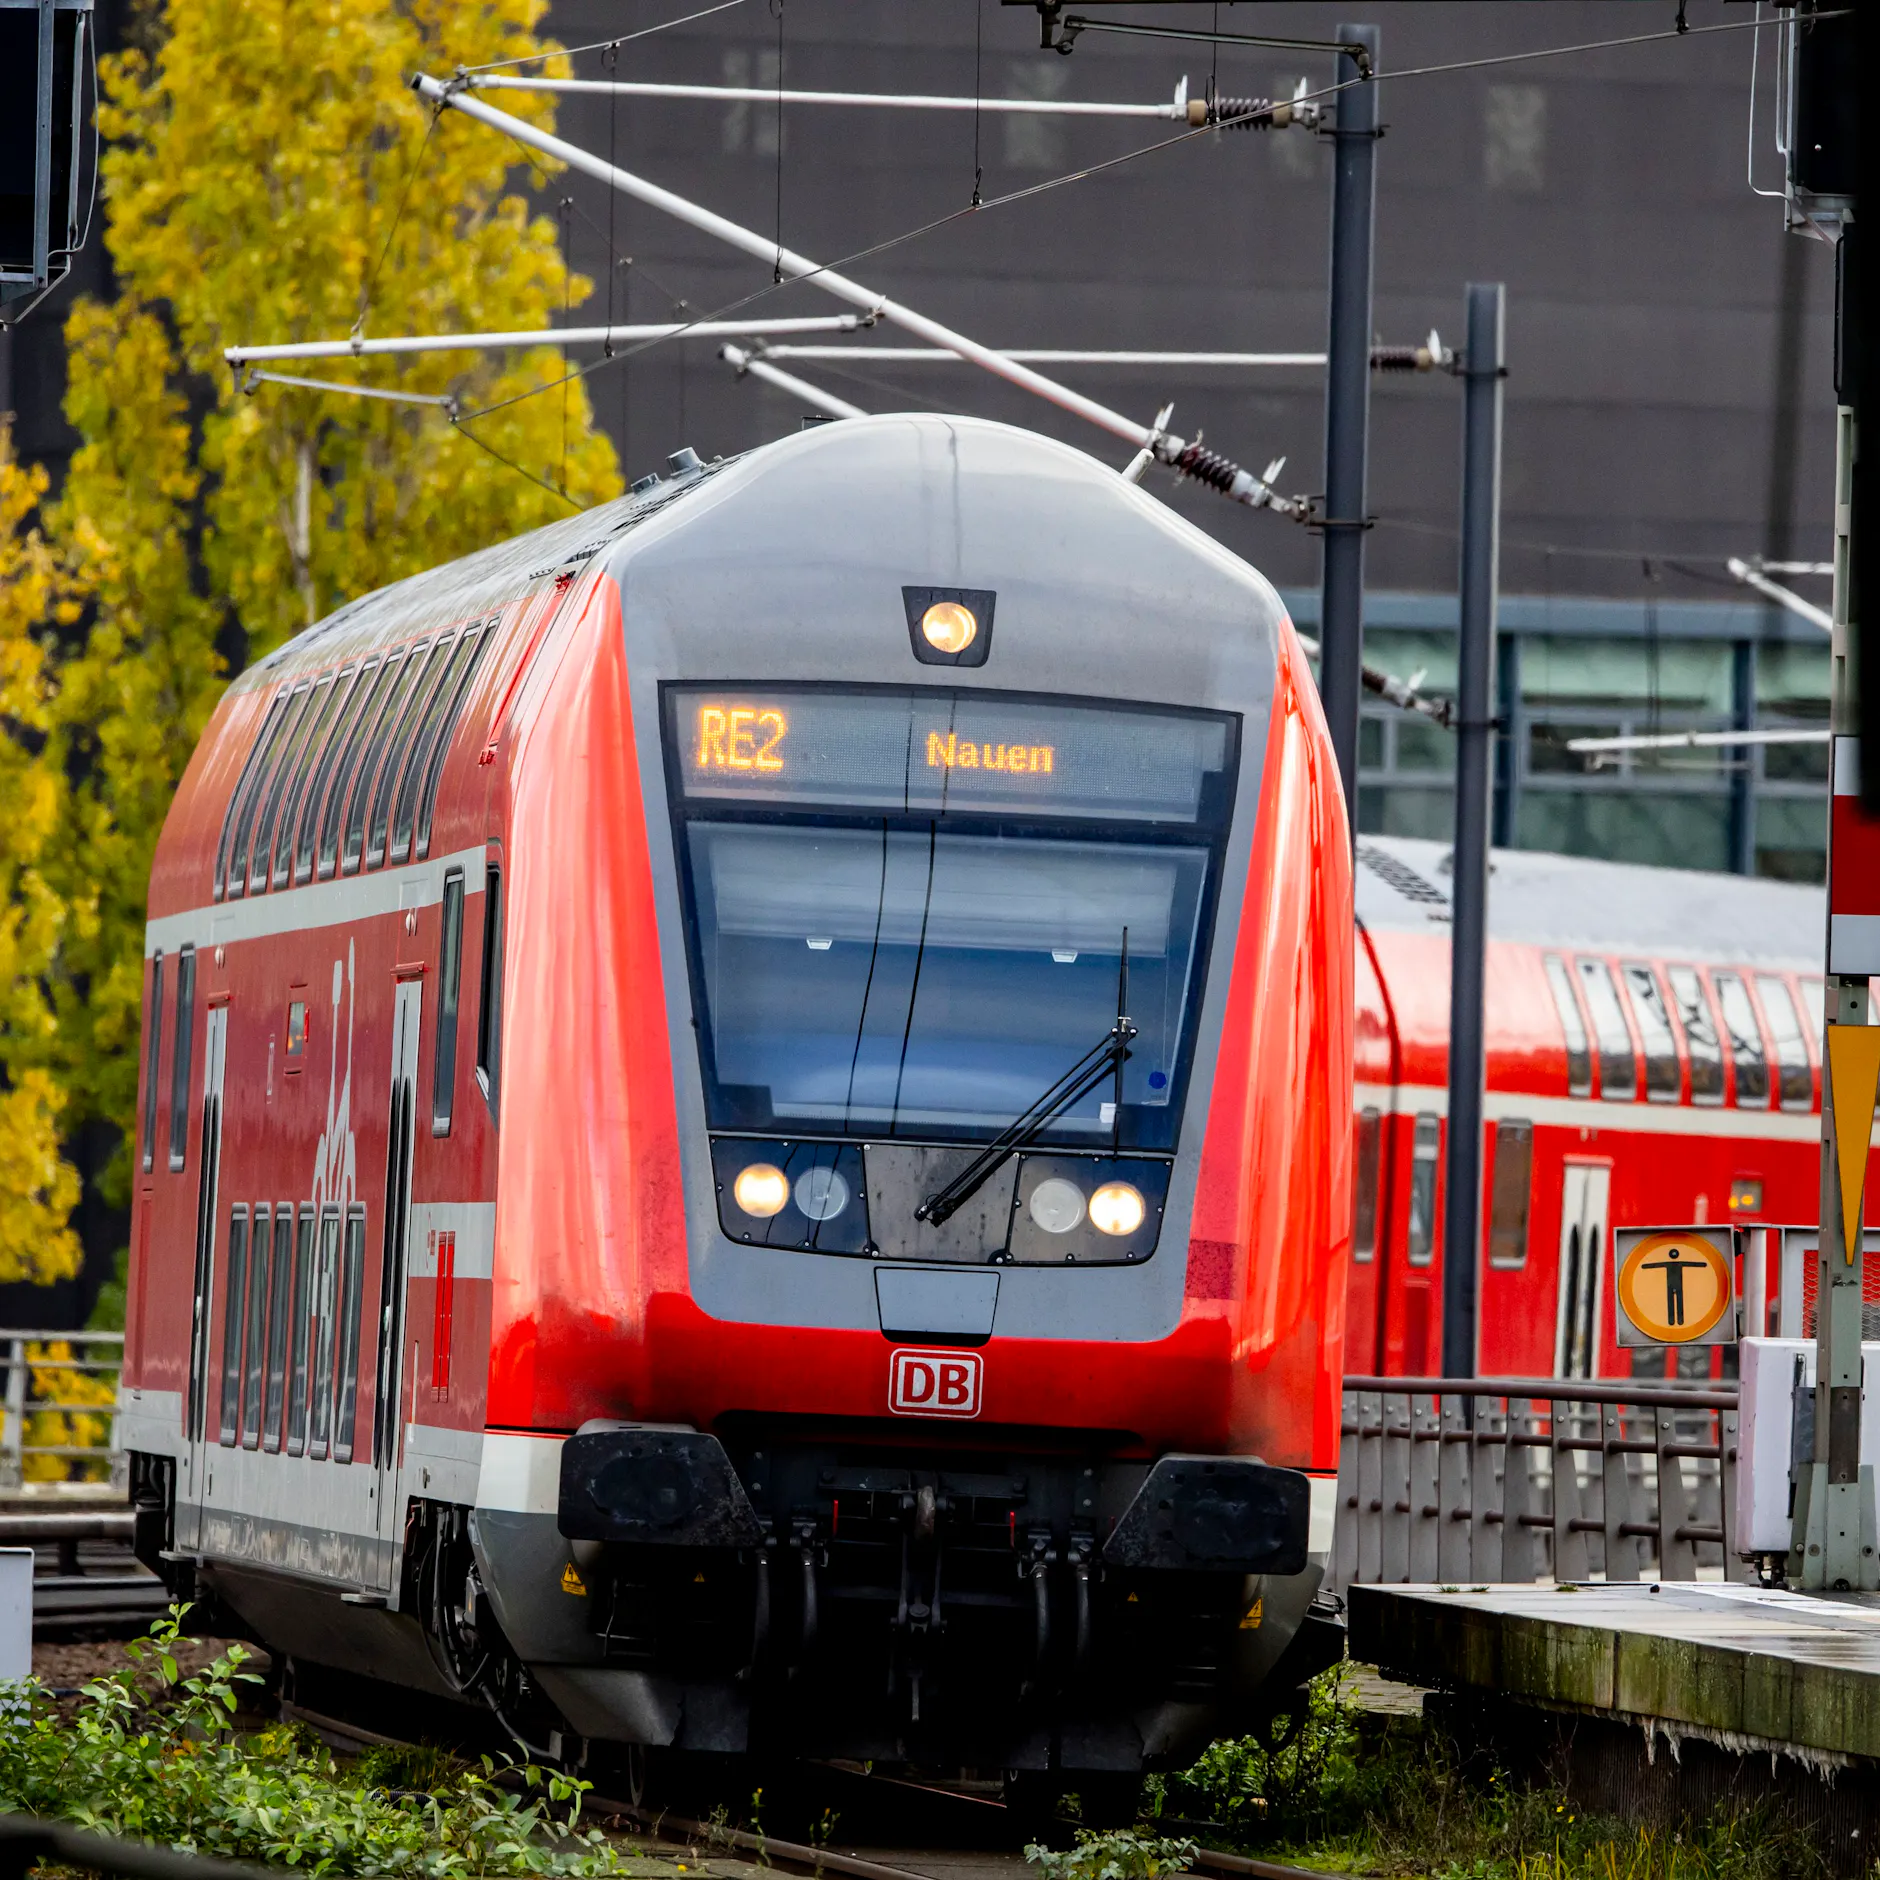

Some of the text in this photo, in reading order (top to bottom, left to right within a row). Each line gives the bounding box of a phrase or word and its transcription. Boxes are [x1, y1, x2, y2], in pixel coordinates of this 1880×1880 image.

[699, 706, 1053, 773] RE2 Nauen
[902, 1361, 969, 1405] DB
